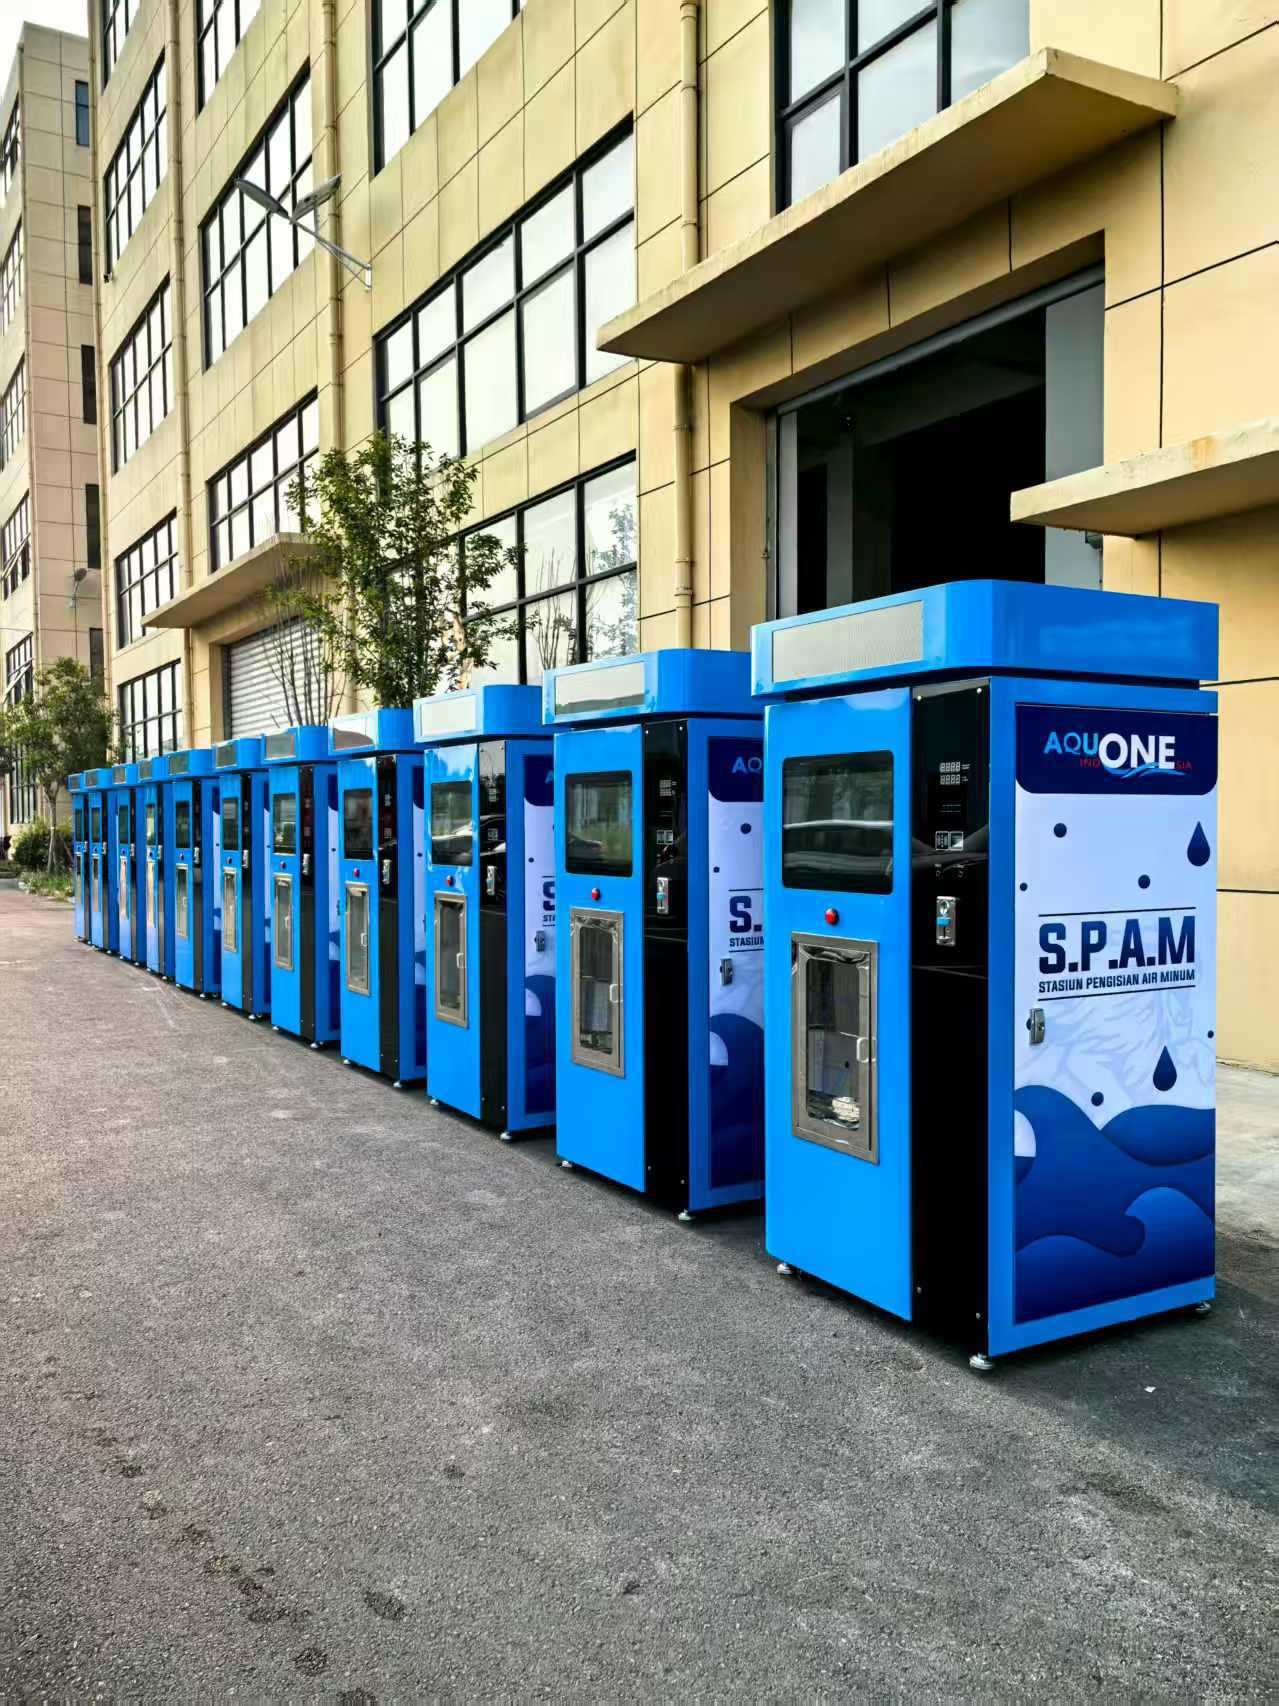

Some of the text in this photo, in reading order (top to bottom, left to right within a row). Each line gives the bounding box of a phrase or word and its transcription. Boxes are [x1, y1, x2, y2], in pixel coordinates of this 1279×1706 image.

[1038, 915, 1196, 975] S.P.A.M
[1038, 969, 1196, 993] STASIUN PENGISIAN AIR MINUM
